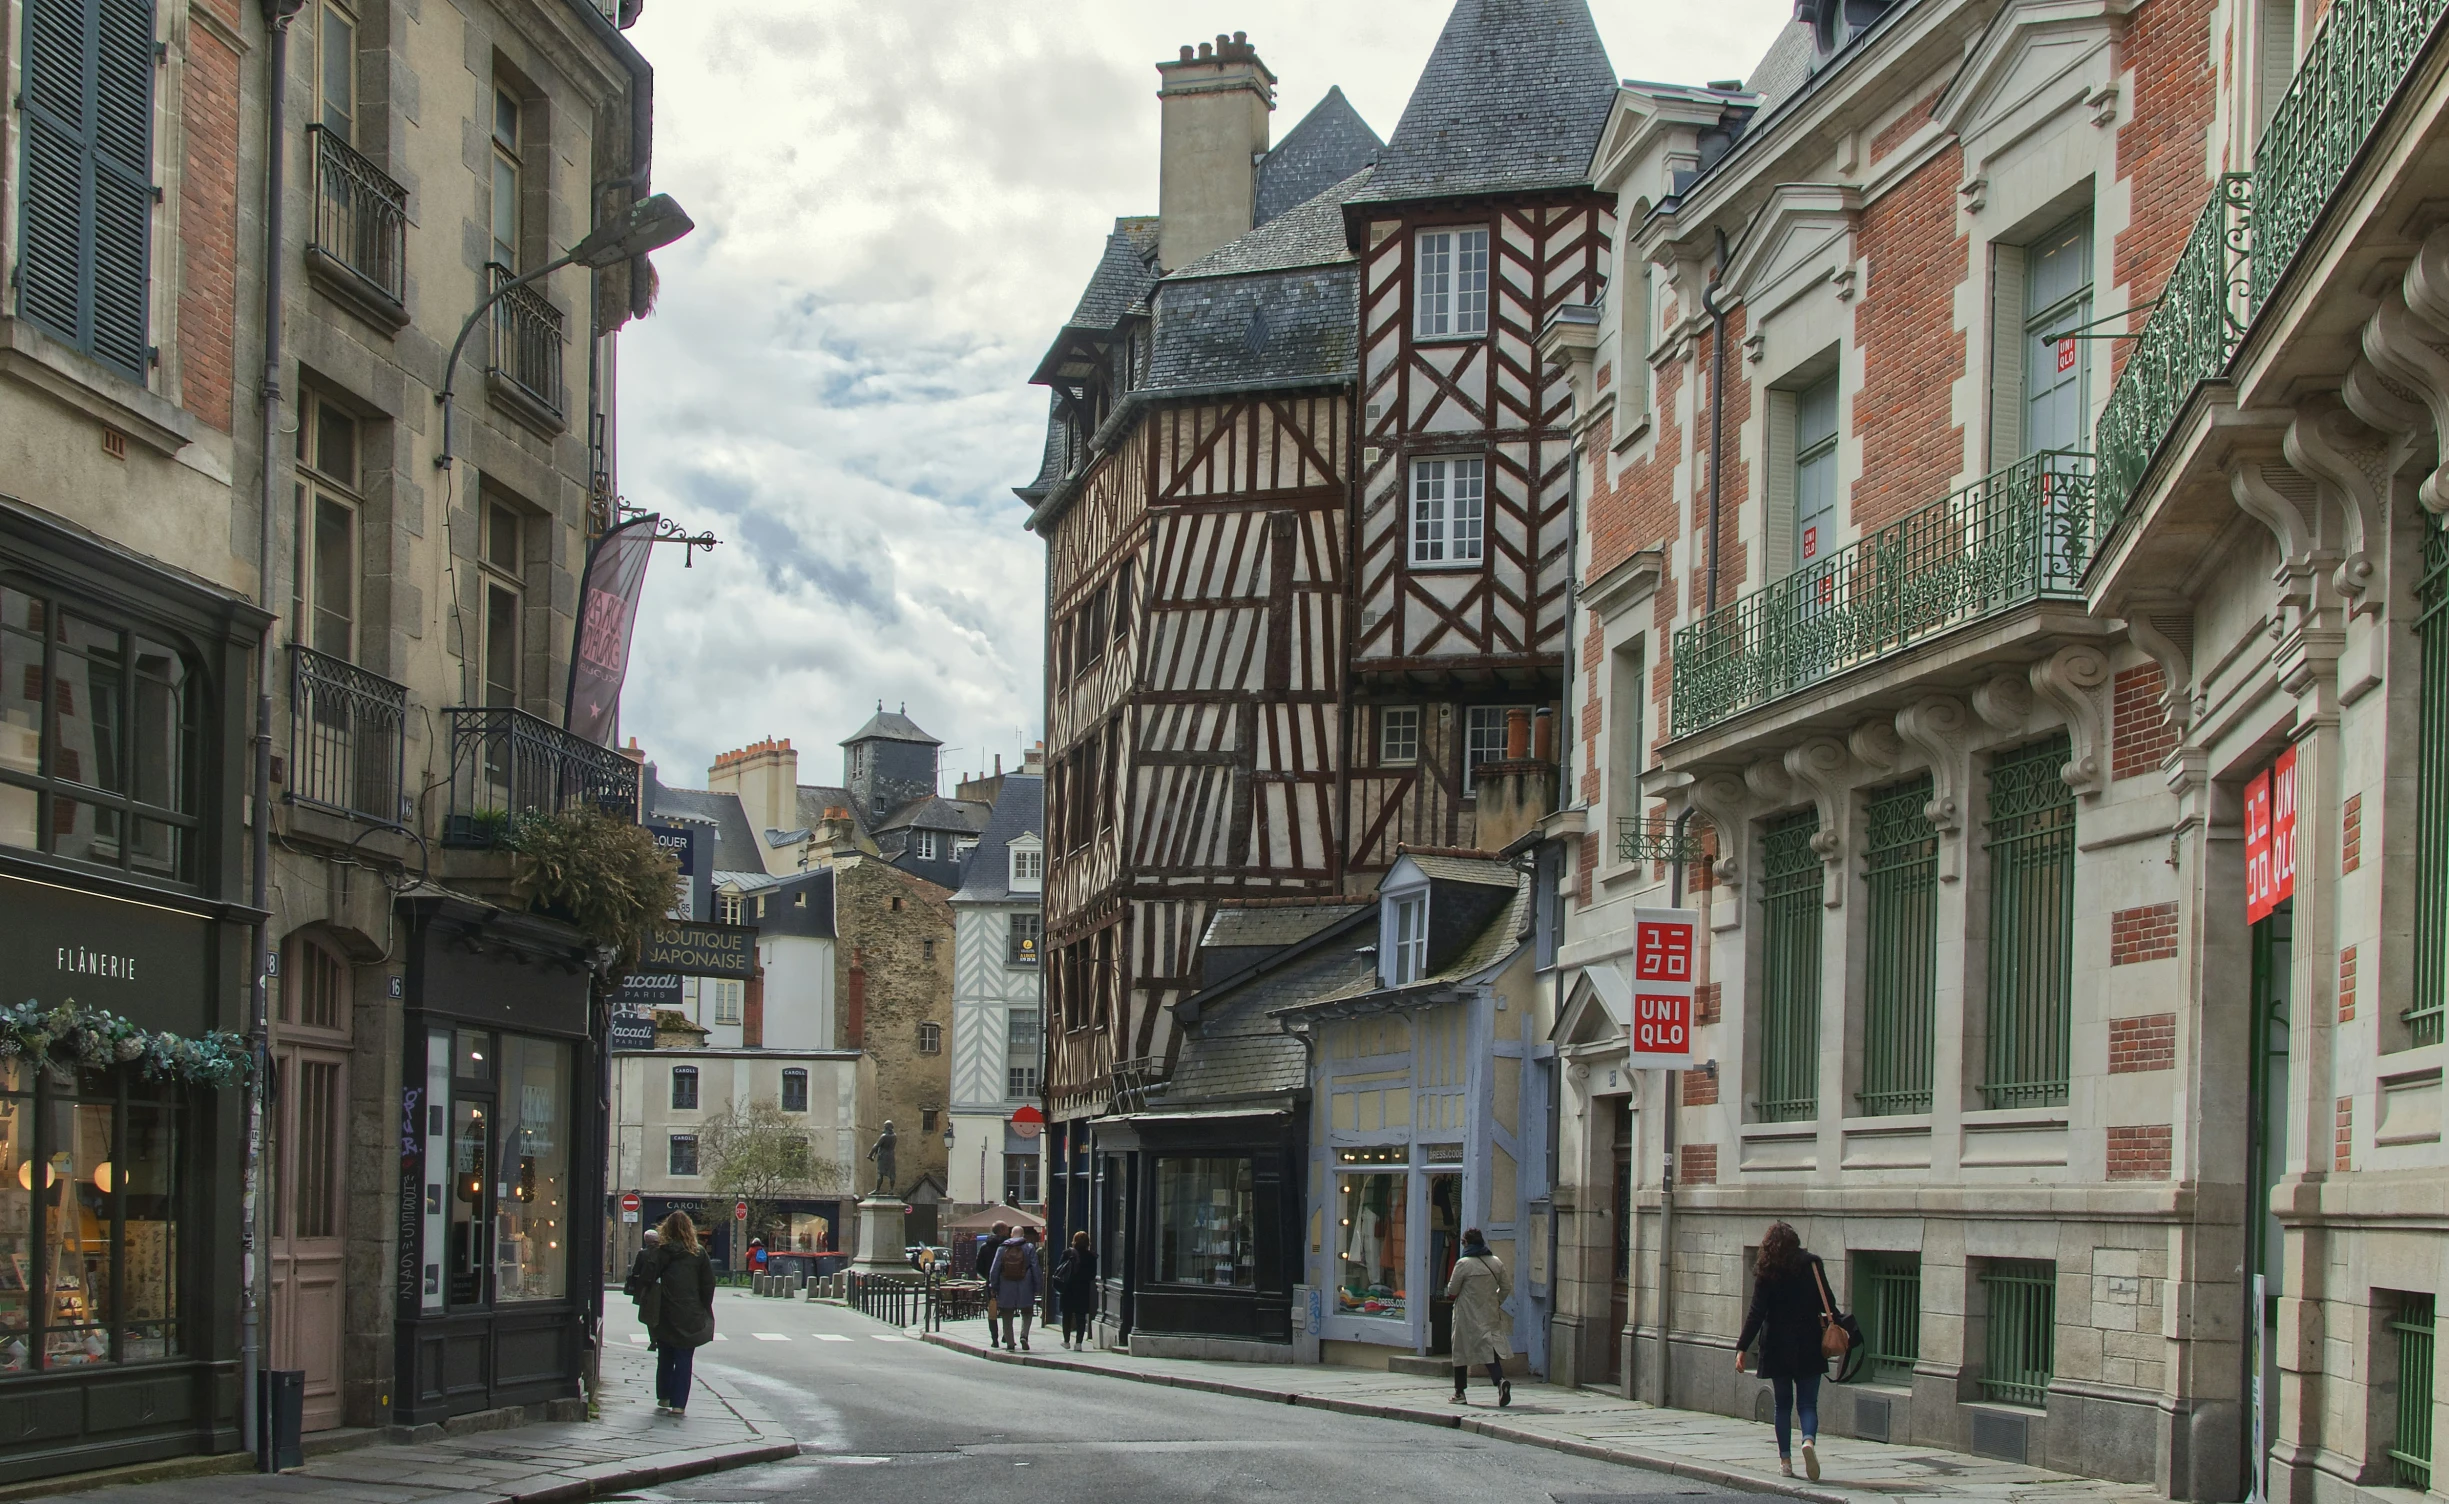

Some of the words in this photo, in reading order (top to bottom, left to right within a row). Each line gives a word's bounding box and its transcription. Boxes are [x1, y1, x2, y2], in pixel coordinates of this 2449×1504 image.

[2060, 338, 2073, 353] UNI
[2059, 352, 2074, 369] QLO
[1804, 530, 1815, 544] UNI
[1804, 542, 1815, 557] QLO
[580, 662, 619, 685] BIJOUX
[2247, 789, 2267, 845] ユニ
[652, 834, 687, 849] LOUER
[2248, 850, 2269, 906] クロ
[655, 929, 742, 951] BOUTIQUE
[1645, 929, 1685, 950] ユニ
[58, 945, 135, 980] FLÂNERIE
[650, 947, 745, 970] JAPONAISE
[1643, 954, 1685, 974] クロ
[391, 978, 400, 996] 16
[622, 973, 678, 989] acadi
[624, 991, 666, 999] PARIS
[1641, 999, 1680, 1021] UNI
[1640, 1024, 1683, 1047] QLO
[666, 1201, 706, 1210] CAROLL
